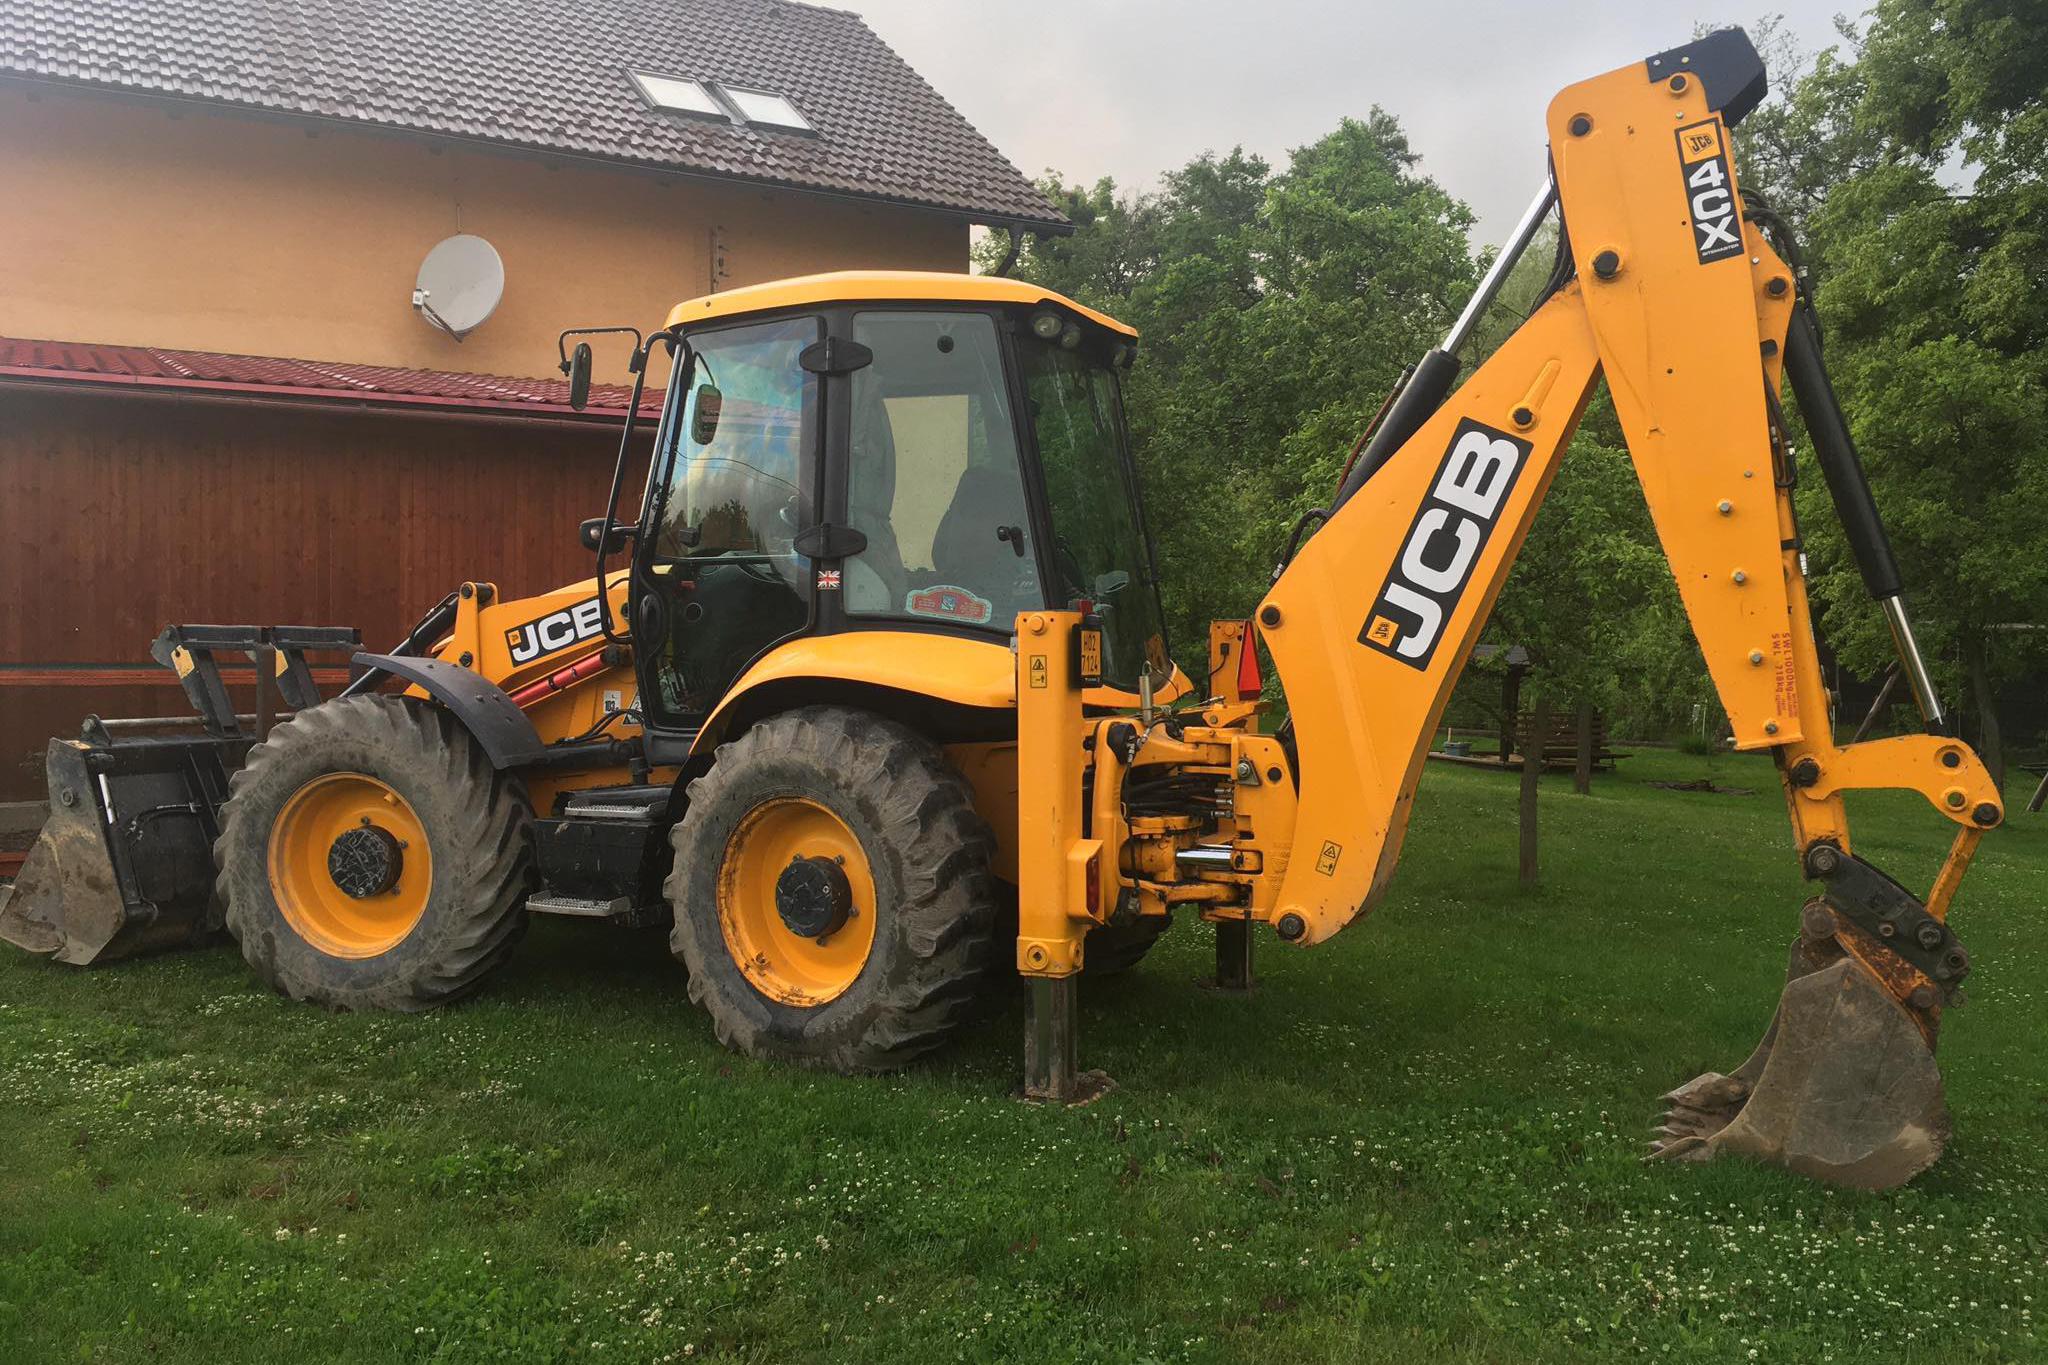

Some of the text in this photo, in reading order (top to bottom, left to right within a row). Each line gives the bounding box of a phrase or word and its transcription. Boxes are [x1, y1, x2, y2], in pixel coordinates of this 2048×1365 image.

[1690, 134, 1713, 152] JCB
[1688, 159, 1740, 251] 4CX
[1384, 431, 1519, 658] JCB
[1082, 655, 1098, 672] 7124
